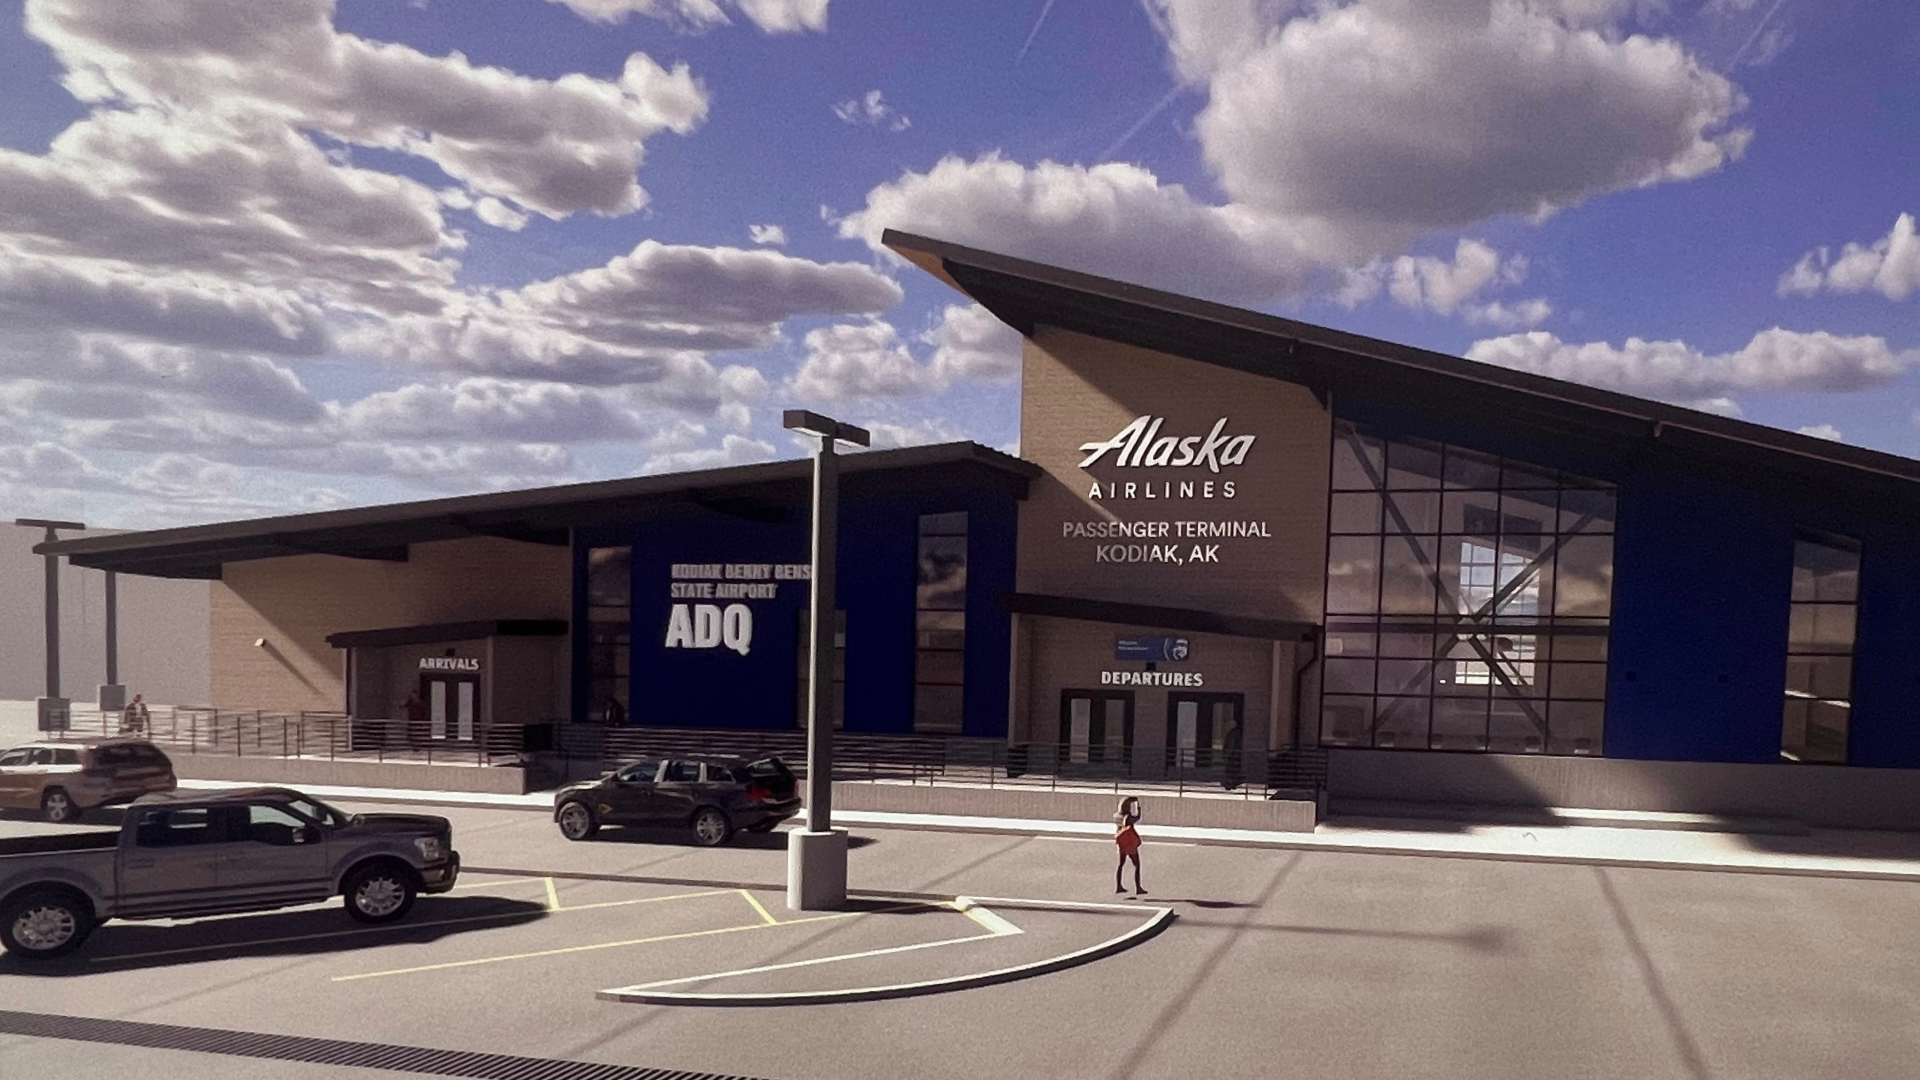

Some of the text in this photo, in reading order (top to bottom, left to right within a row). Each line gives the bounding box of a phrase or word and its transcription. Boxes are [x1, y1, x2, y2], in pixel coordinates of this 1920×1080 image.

[1078, 415, 1257, 474] Alaska
[1088, 481, 1236, 499] AIRLINES
[1063, 521, 1271, 538] PASSENGER TERMINAL
[1096, 544, 1219, 566] KODIAK, AK
[671, 563, 812, 580] KODIAK BENNY BENS
[671, 582, 777, 599] STATE AIRPORT
[664, 603, 753, 656] ADQ
[419, 657, 479, 671] ARRIVALS
[1101, 671, 1204, 687] DEPARTURES
